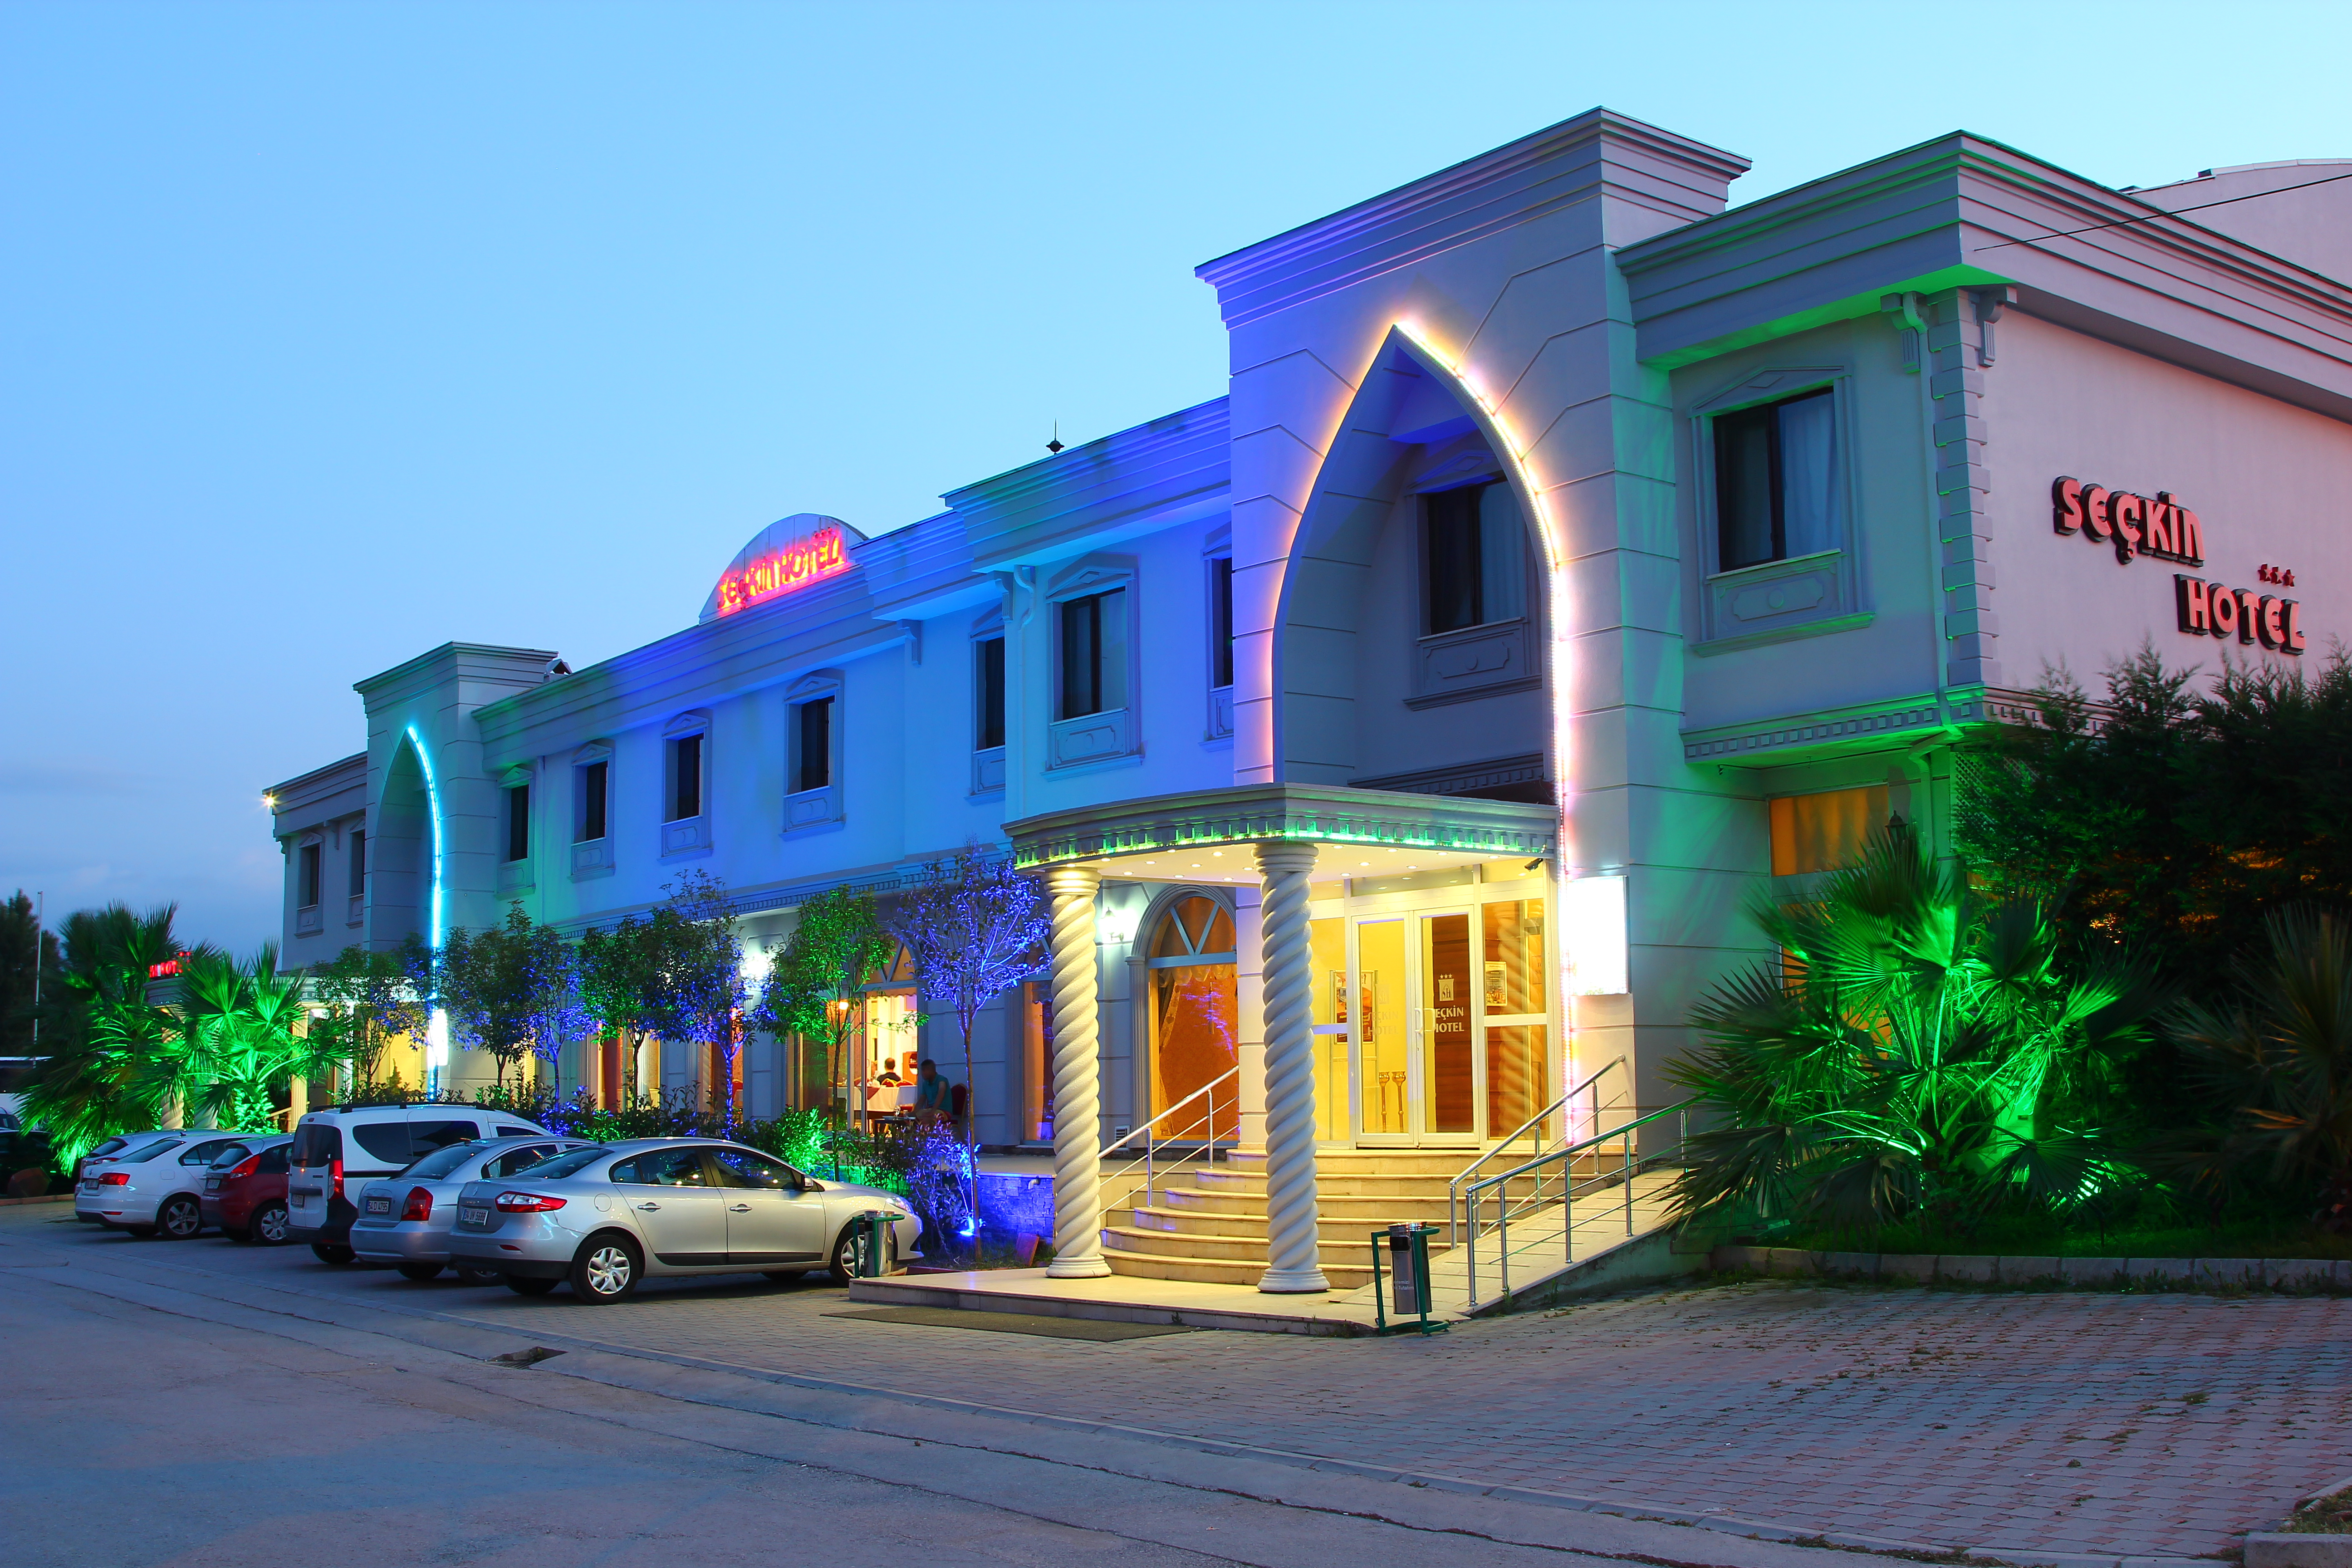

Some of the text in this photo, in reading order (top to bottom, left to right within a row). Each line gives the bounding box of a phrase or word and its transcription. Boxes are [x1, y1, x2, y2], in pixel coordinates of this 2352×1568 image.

[780, 534, 841, 583] HOTEL
[2173, 573, 2305, 656] HOTEL
[1436, 1005, 1464, 1020] EÇKİN
